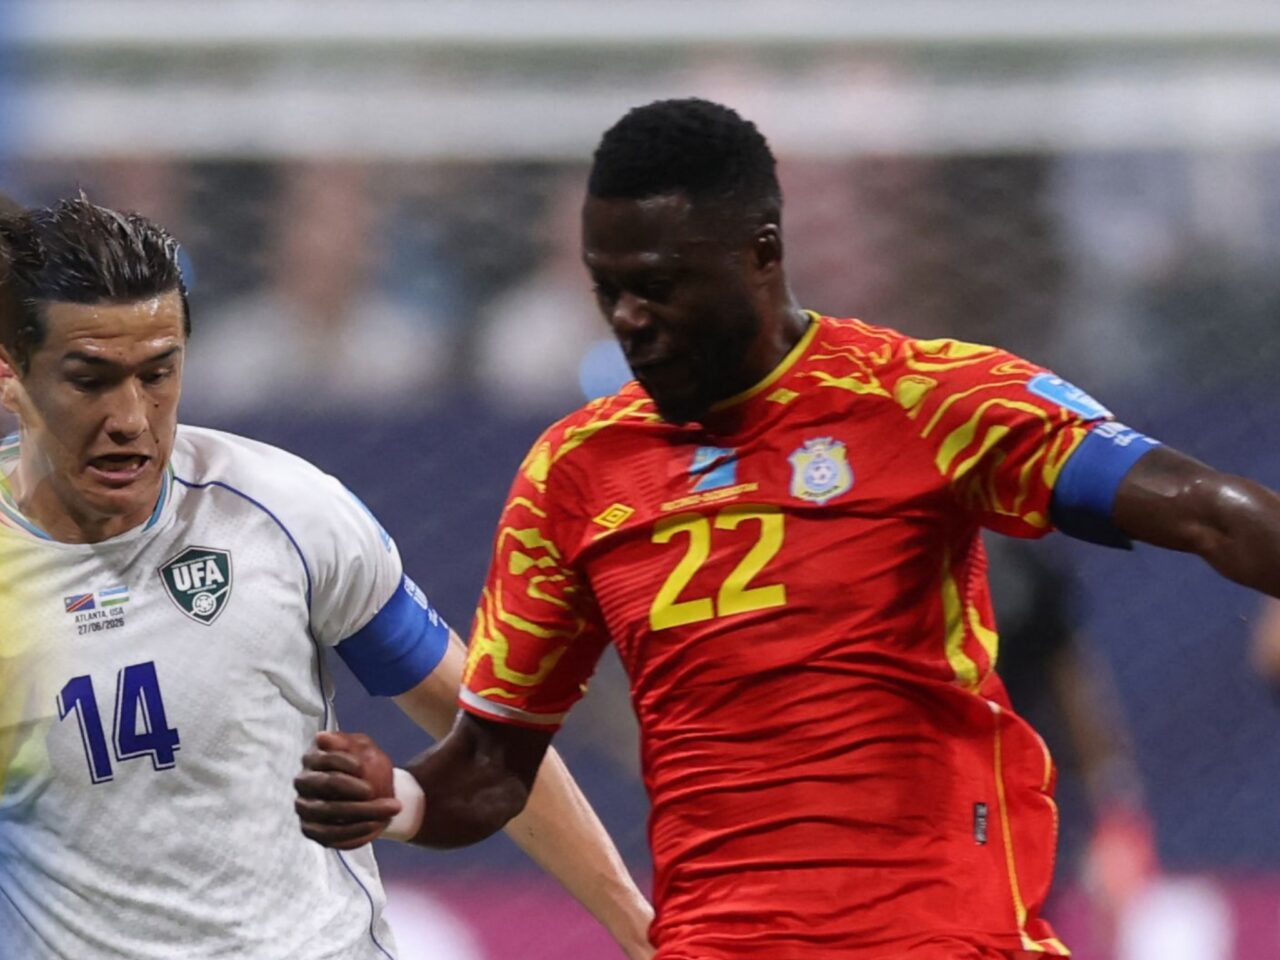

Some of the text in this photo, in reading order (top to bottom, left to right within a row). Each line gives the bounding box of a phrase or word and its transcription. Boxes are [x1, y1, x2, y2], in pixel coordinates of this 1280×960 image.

[172, 559, 225, 592] UFA
[649, 503, 787, 632] 22
[75, 607, 125, 623] ATLANTA, USA
[56, 660, 181, 785] 14
